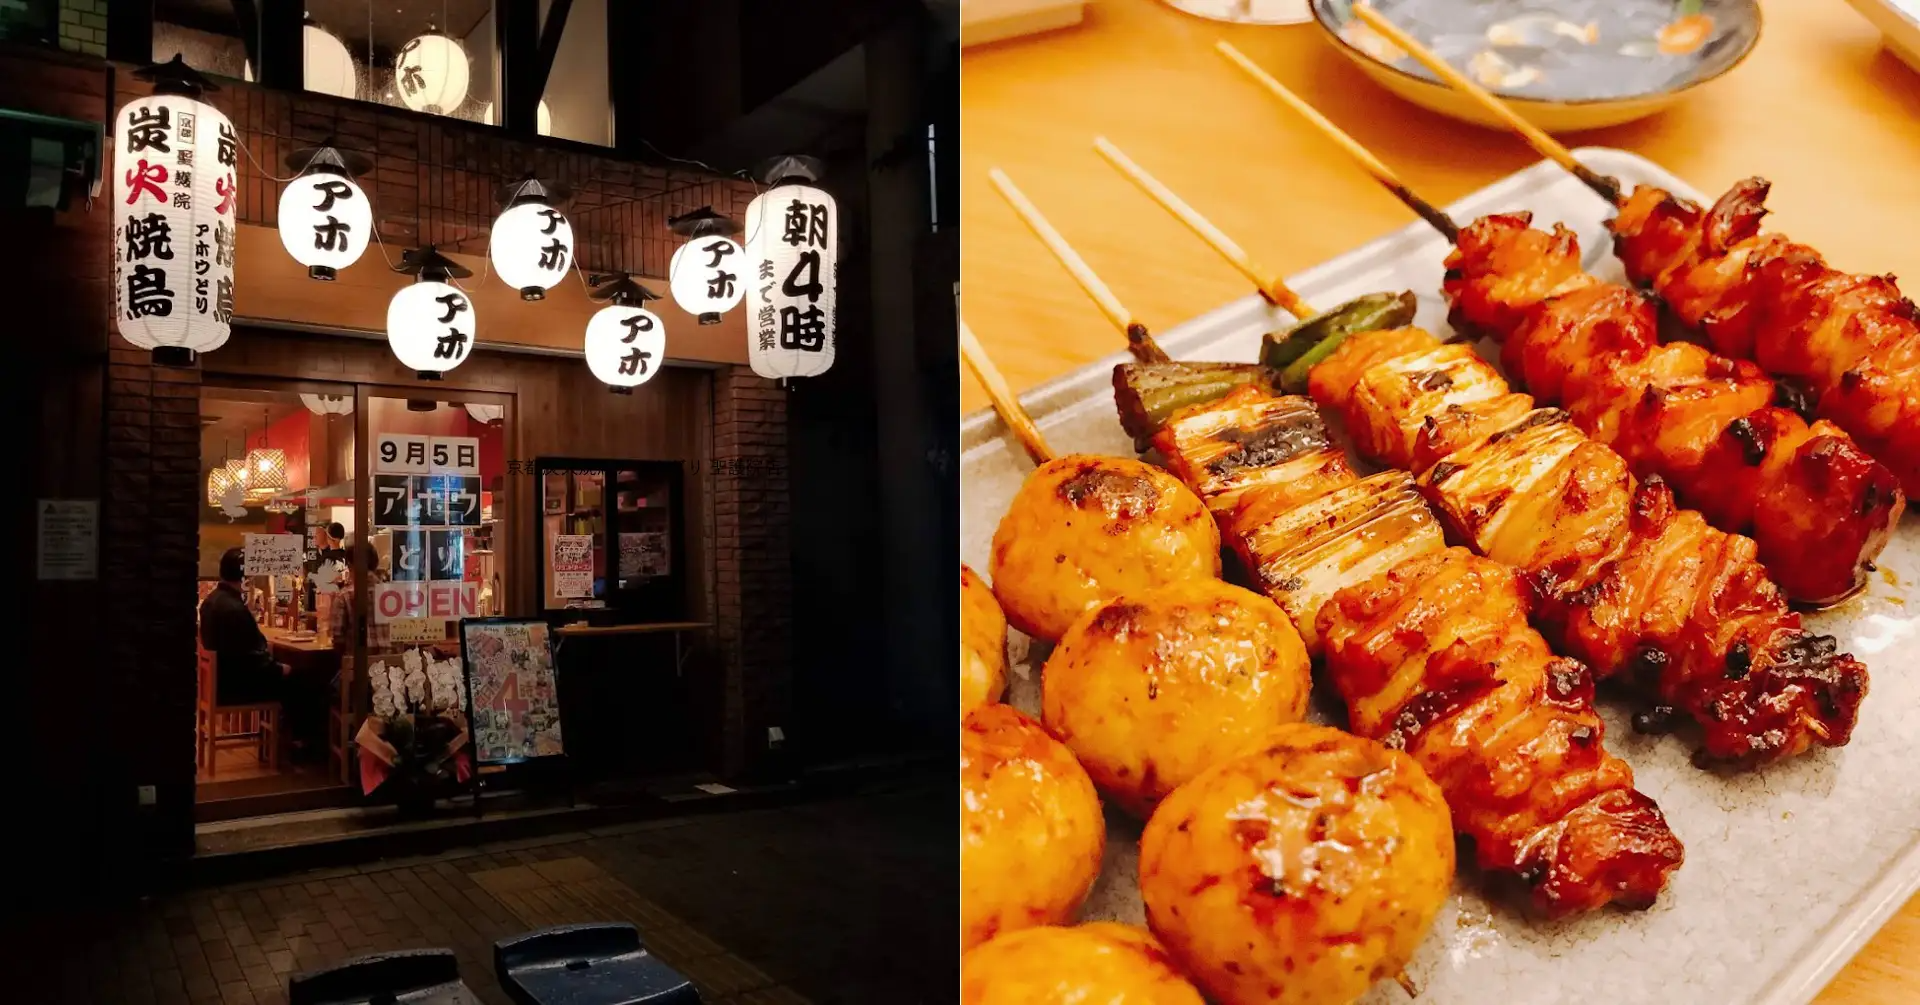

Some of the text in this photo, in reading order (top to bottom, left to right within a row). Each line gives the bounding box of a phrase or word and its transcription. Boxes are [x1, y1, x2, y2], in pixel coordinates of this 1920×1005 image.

[125, 106, 175, 321] 炭火焼鳥
[312, 180, 354, 253] アホ
[537, 208, 568, 273] アホ
[195, 224, 211, 315] アホウどり
[702, 240, 737, 300] アホ
[779, 199, 829, 353] 朝4時
[434, 293, 469, 360] アホ
[758, 258, 777, 352] まで営業
[618, 315, 654, 376] アホ
[380, 440, 476, 468] 9月5日
[378, 585, 477, 618] OPEN
[492, 671, 530, 724] 4
